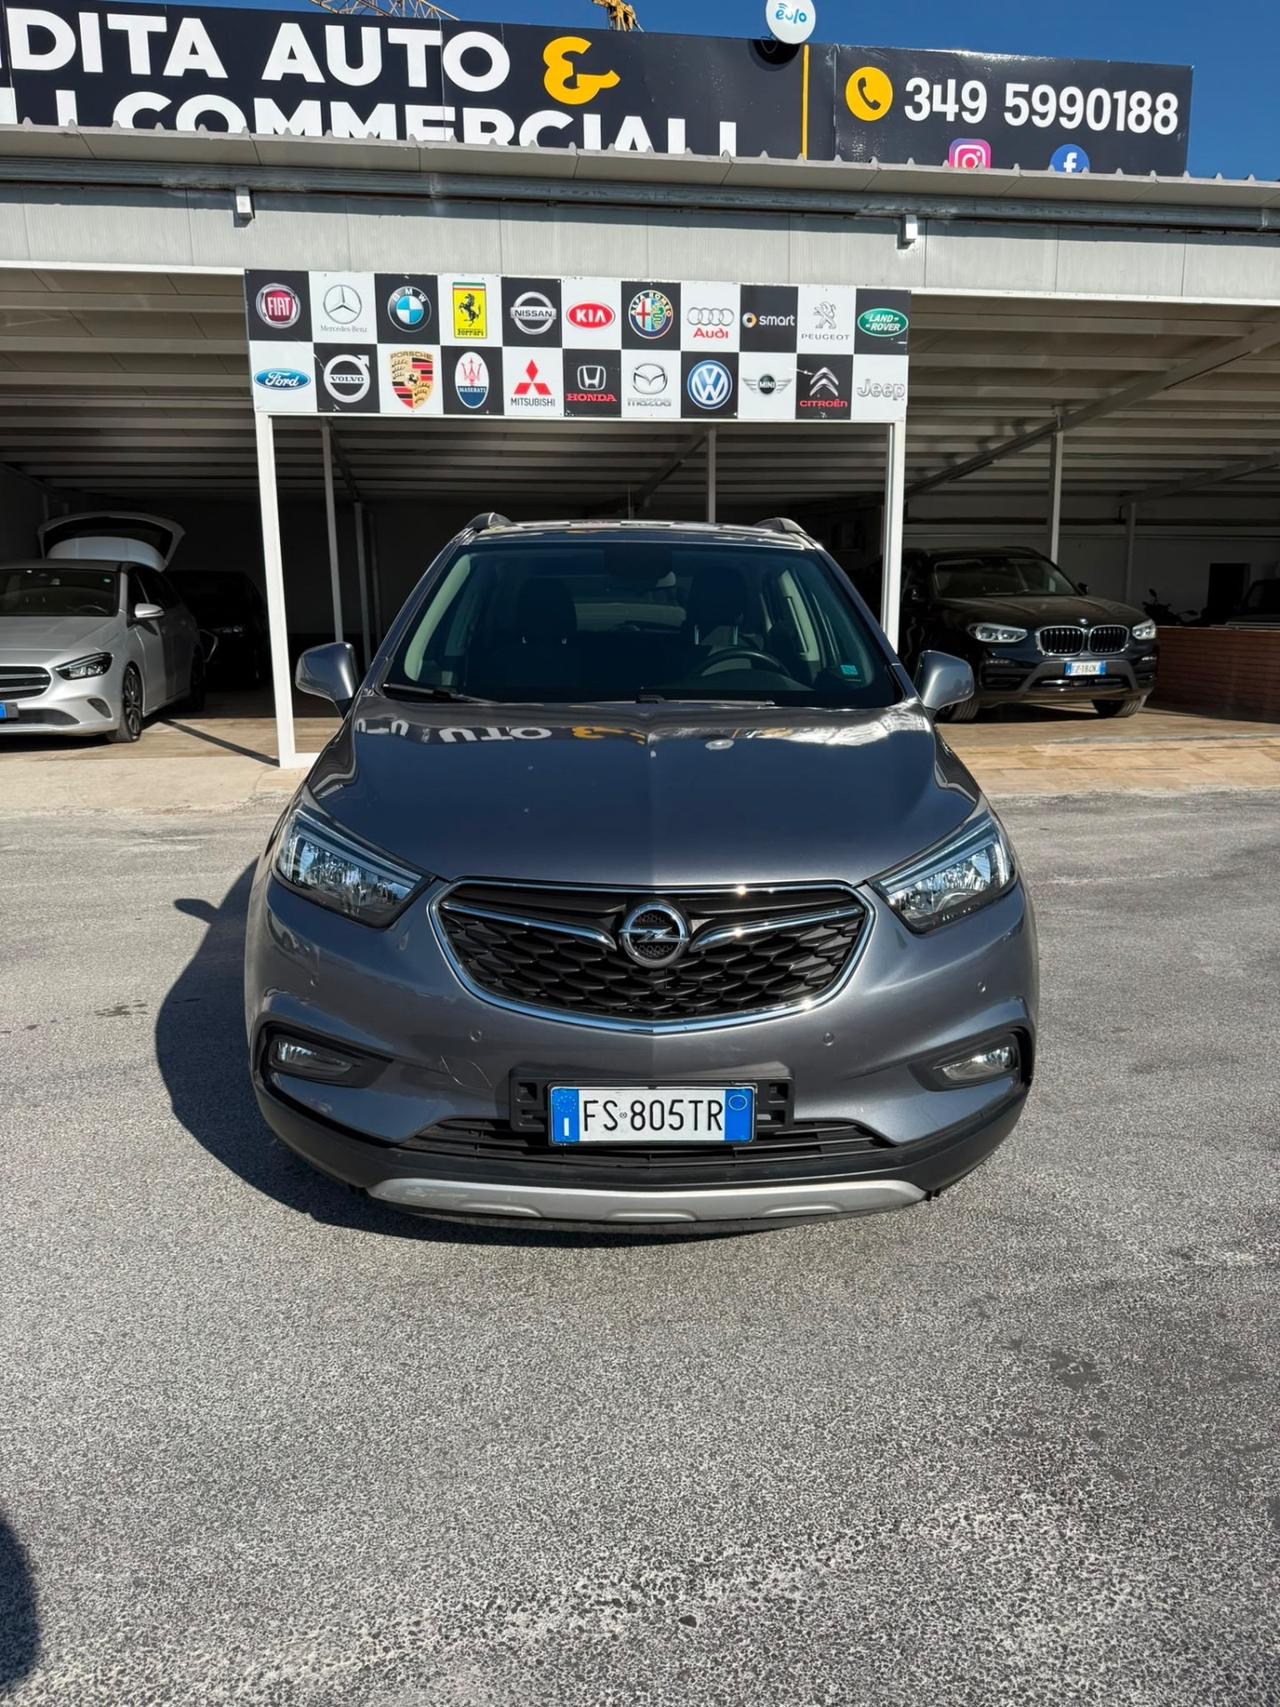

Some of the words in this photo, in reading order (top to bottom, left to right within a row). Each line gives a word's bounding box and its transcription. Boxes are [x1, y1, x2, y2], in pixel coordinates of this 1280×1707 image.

[0, 8, 229, 79] DITA
[262, 22, 510, 93] AUTO
[904, 77, 988, 124] 349
[1003, 83, 1178, 135] 5990188
[267, 297, 290, 316] FIAT
[576, 308, 606, 323] KIA
[759, 314, 795, 327] smart
[693, 327, 729, 339] Audi
[391, 351, 433, 361] PORSCHE
[265, 372, 300, 387] Ford
[857, 379, 905, 400] Jeep
[511, 398, 556, 407] MITSUBISHI
[566, 393, 617, 402] HONDA
